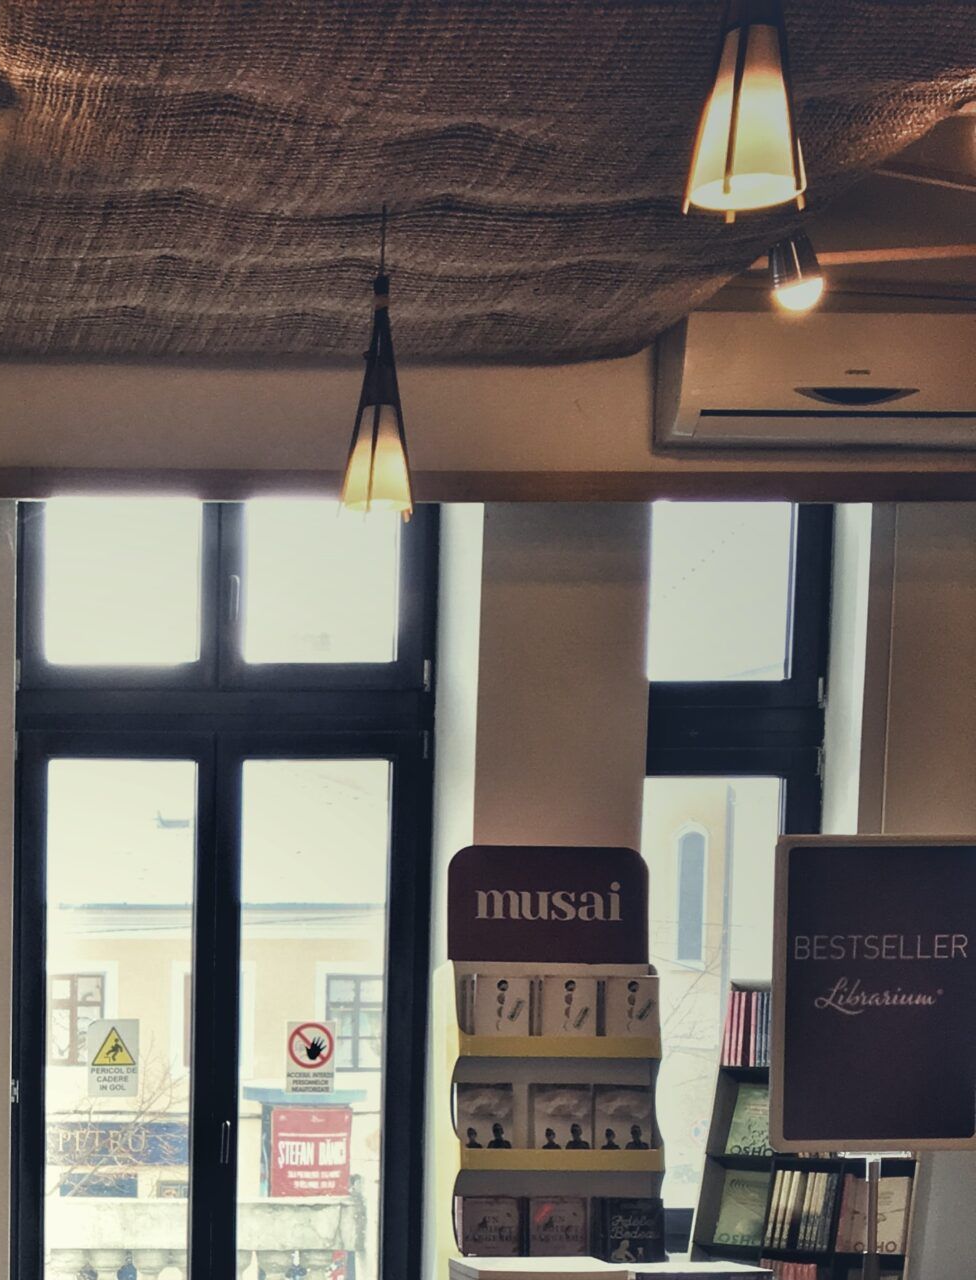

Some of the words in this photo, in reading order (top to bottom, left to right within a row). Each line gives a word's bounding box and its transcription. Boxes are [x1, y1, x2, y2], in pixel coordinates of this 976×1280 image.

[474, 881, 623, 922] musai
[794, 934, 968, 960] BESTSELLER
[814, 976, 936, 1015] Librarium
[90, 1067, 123, 1075] PERICOL
[96, 1075, 129, 1083] CADERE
[729, 1144, 774, 1156] OSHO
